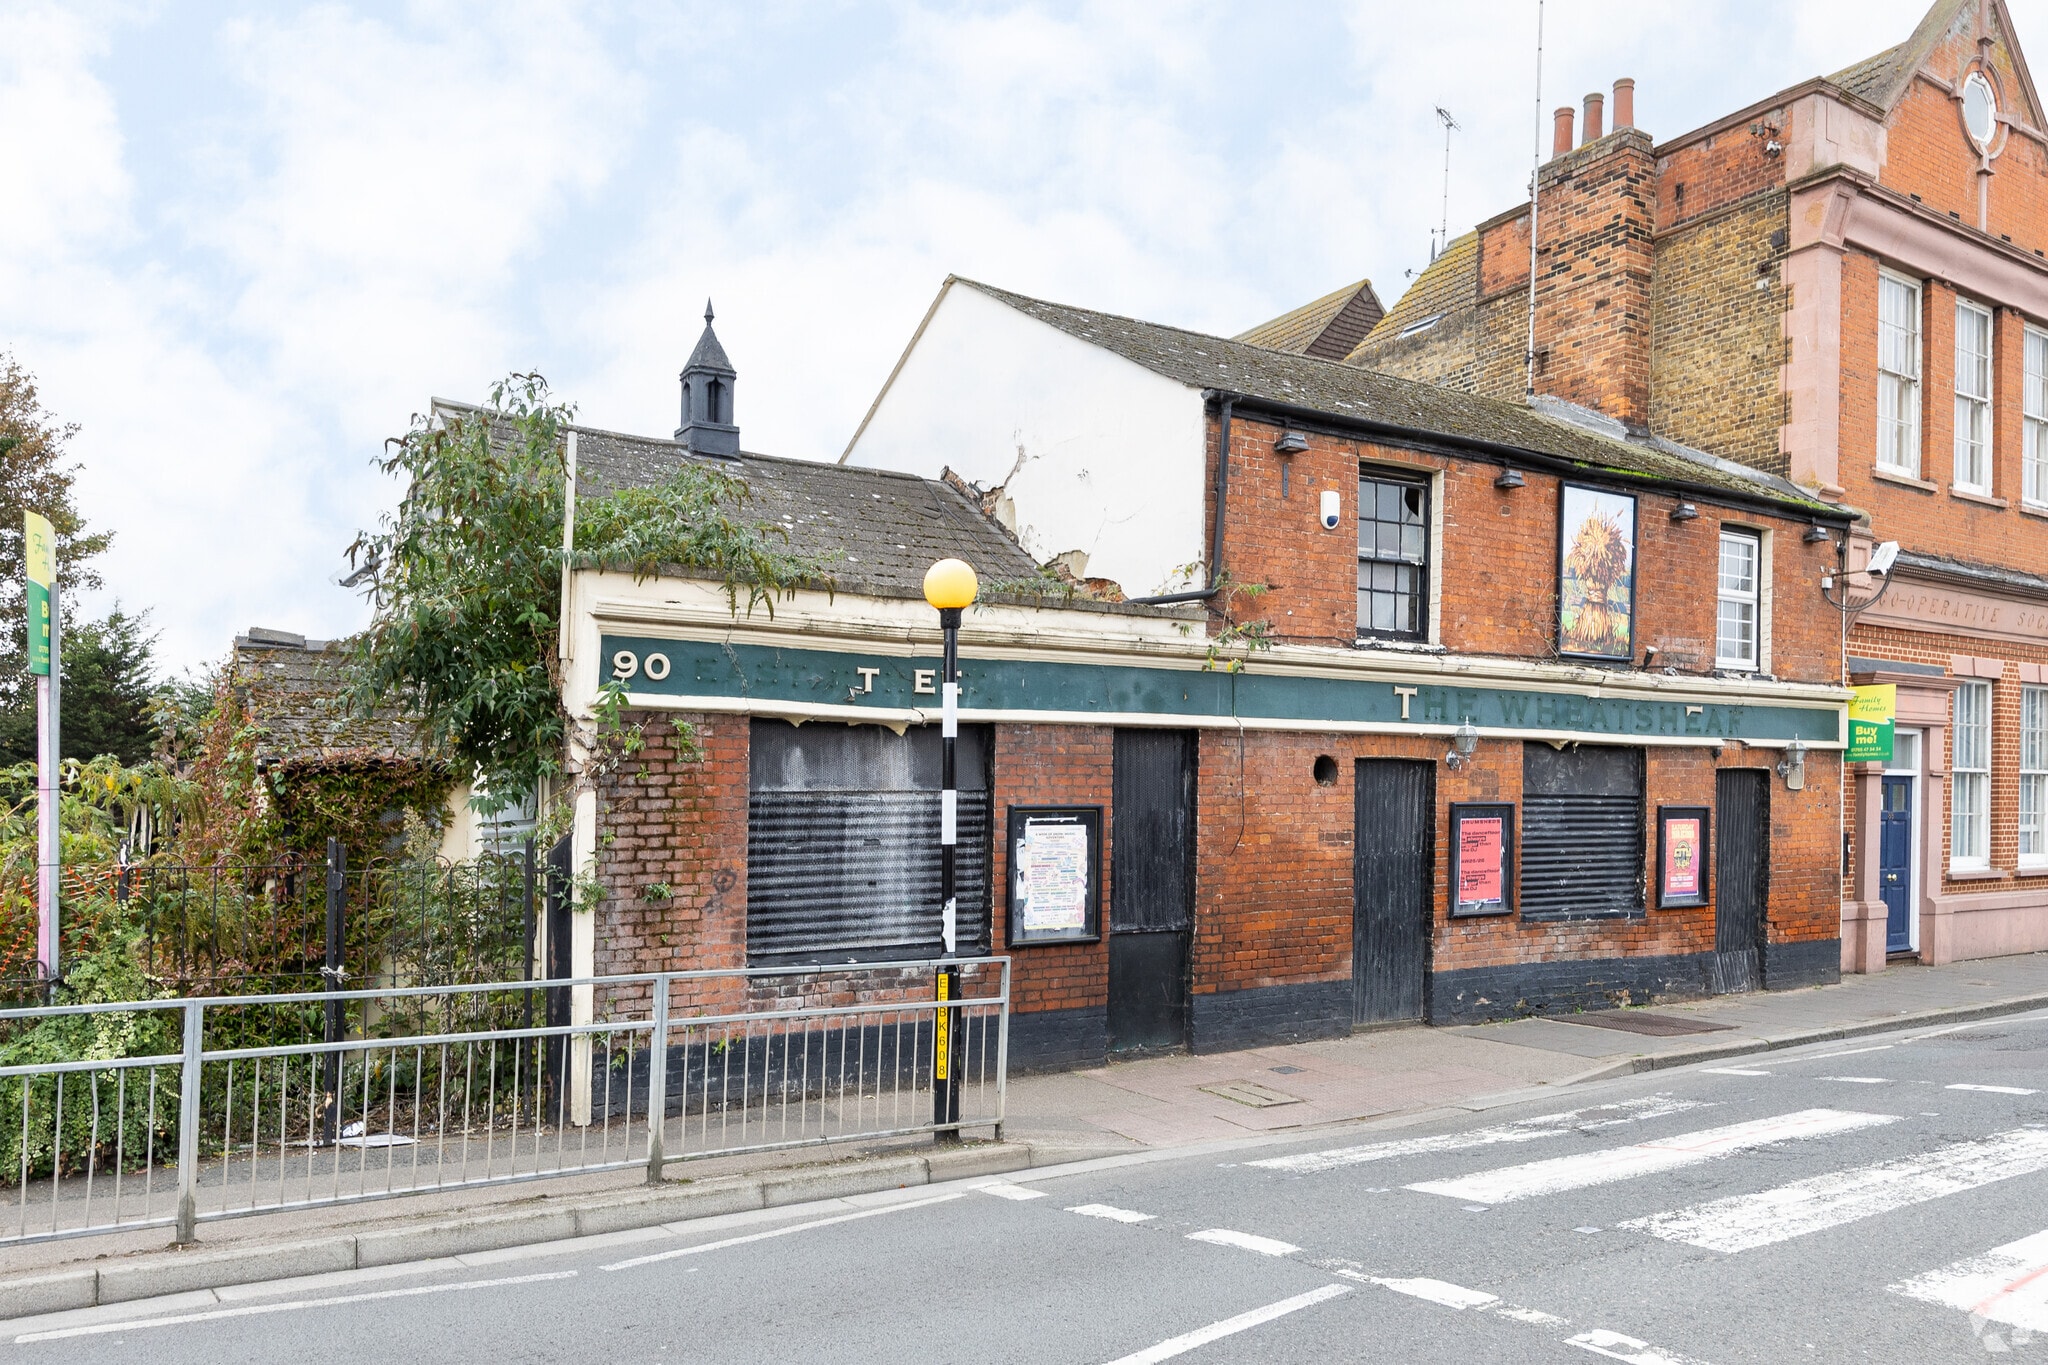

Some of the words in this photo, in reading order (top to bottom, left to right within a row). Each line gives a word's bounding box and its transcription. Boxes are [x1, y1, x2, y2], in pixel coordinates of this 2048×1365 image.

[1879, 591, 2001, 623] CO-OPERATIVE
[2017, 612, 2048, 630] SOC
[612, 650, 671, 681] 90
[1851, 695, 1882, 706] Family
[1858, 704, 1887, 712] Homes
[1855, 726, 1878, 737] Buy
[1855, 734, 1877, 744] me!
